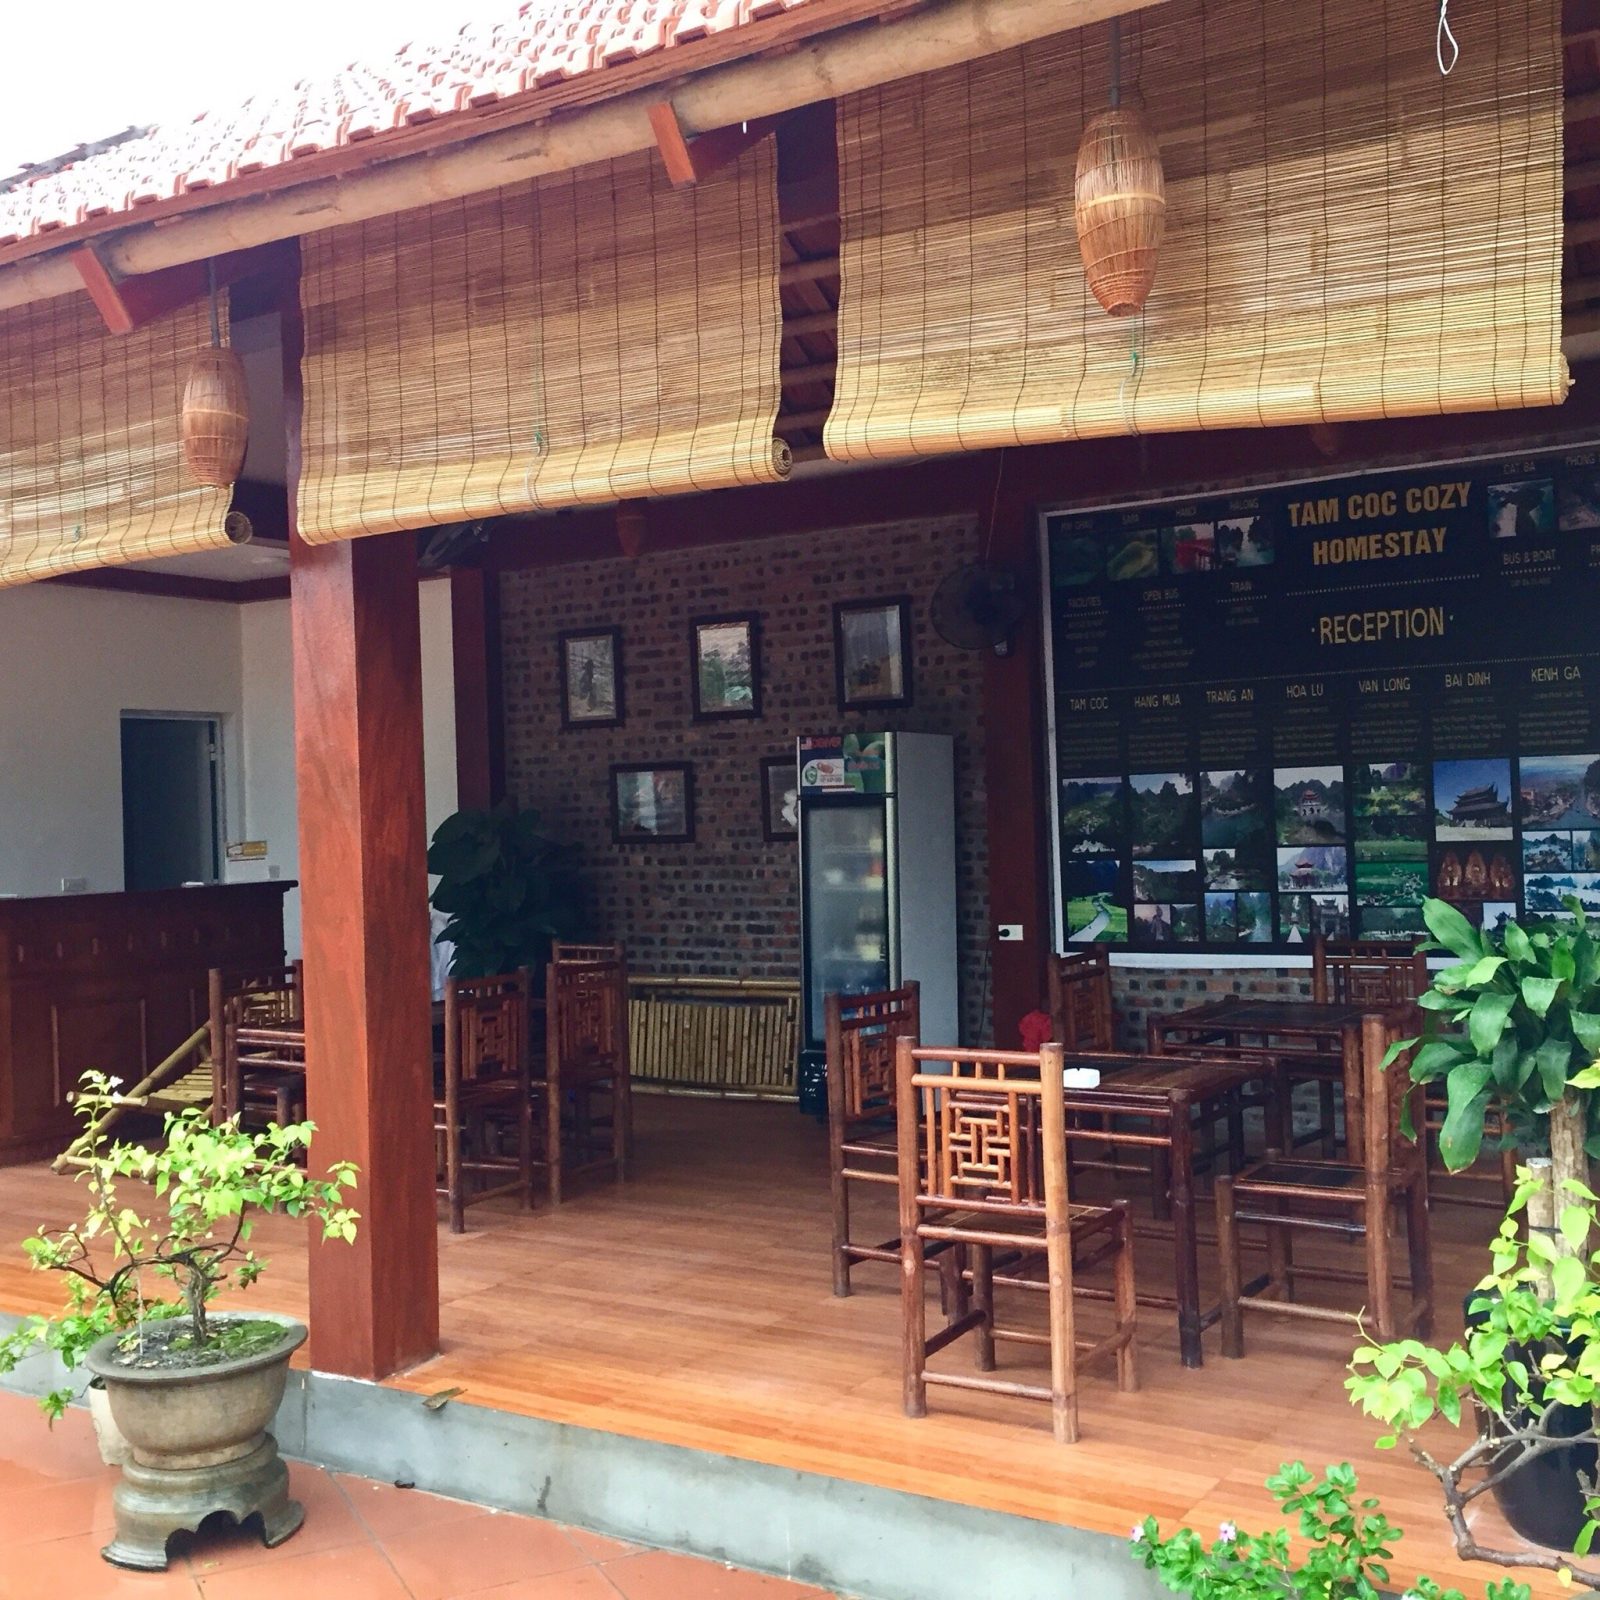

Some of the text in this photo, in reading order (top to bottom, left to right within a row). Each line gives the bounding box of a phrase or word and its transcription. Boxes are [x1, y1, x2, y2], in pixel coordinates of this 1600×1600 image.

[1288, 481, 1471, 527] TAM COC COZY
[1312, 527, 1448, 565] HOMESTAY
[1503, 552, 1521, 565] BUS
[1533, 548, 1556, 562] BOAT
[1319, 607, 1445, 644] RECEPTION
[1445, 671, 1491, 688] BAI DINH
[1531, 666, 1581, 682] KENH GA
[1286, 683, 1324, 698] HOA LU
[1358, 677, 1411, 693] VAN LONG
[1134, 692, 1181, 708] HANG MUA
[1206, 688, 1254, 703] TRANG AN
[1070, 697, 1109, 711] TAM COC
